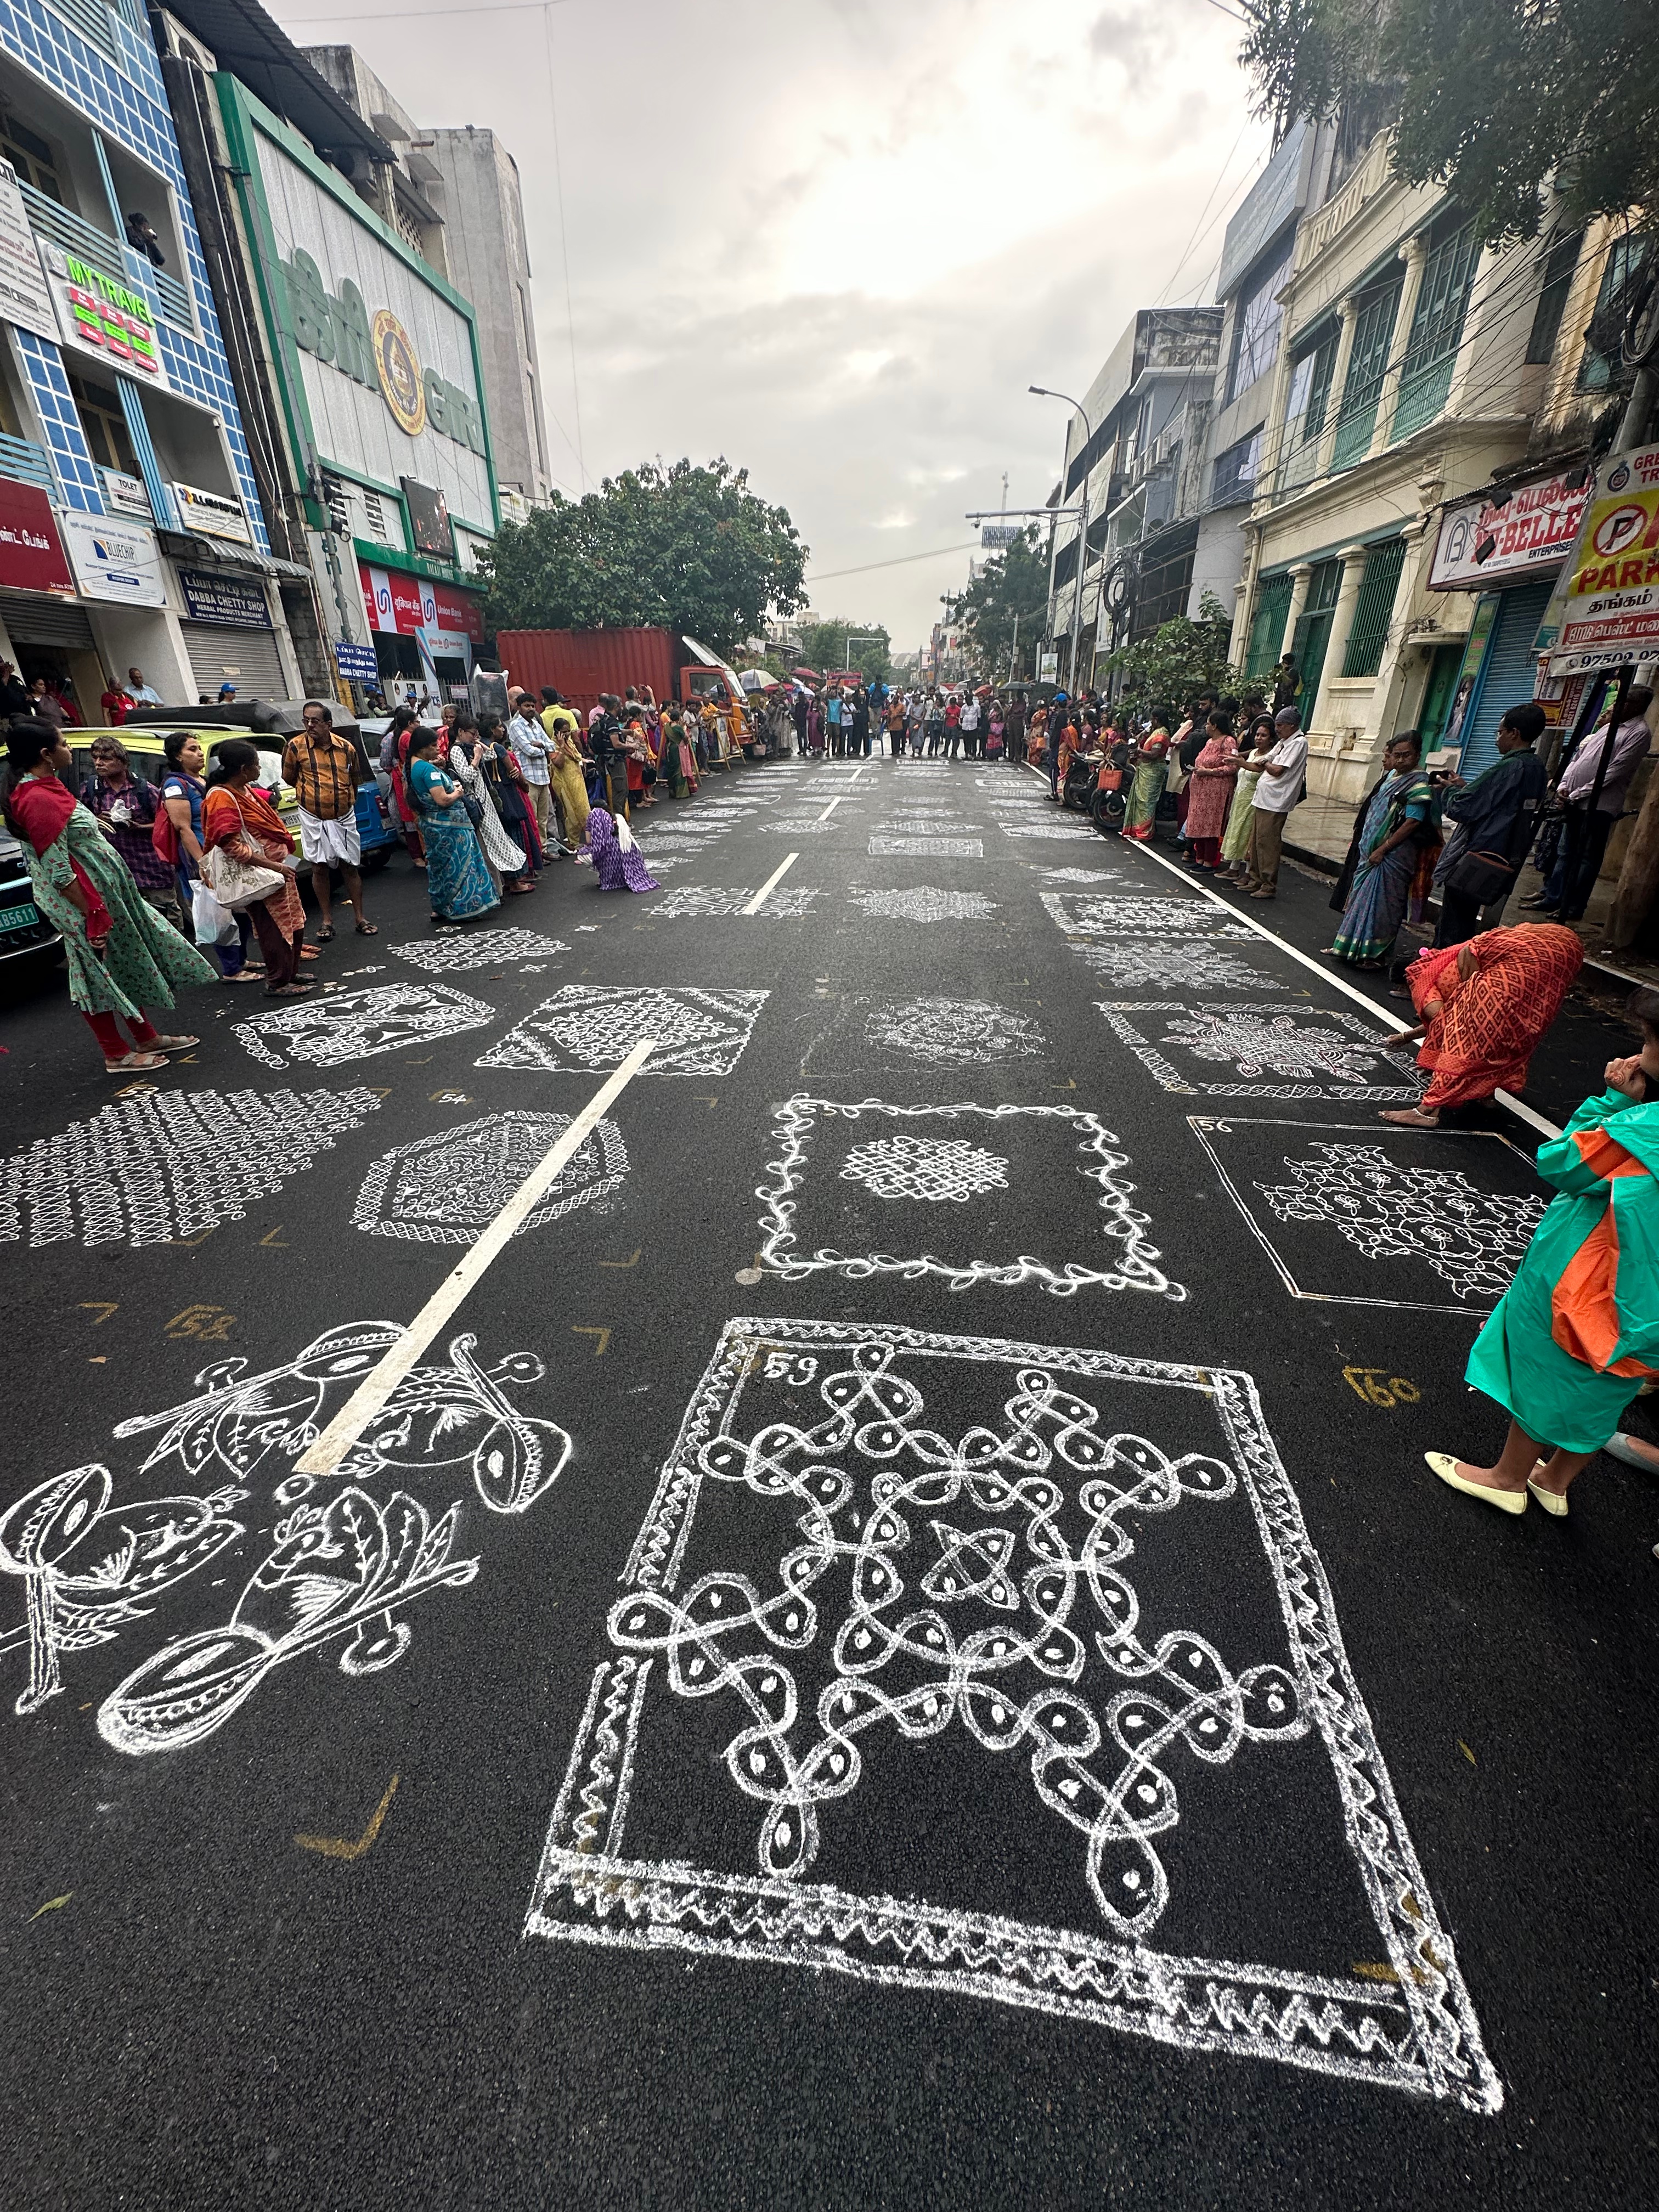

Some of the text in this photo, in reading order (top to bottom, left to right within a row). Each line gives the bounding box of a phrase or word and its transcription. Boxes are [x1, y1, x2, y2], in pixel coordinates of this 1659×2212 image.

[67, 255, 93, 290] MY
[95, 272, 156, 328] TRAVEL
[422, 367, 487, 459] GIRI
[106, 541, 134, 561] BLUECHIP
[188, 590, 265, 612] DABBA CHETTY SHOP
[217, 607, 241, 616] PRODUCTS
[437, 605, 462, 618] Union Bank
[1639, 650, 1659, 662] 97
[352, 669, 366, 678] CHETTY
[438, 1093, 467, 1104] 54
[1197, 1120, 1232, 1132] 56
[764, 1352, 819, 1386] 59
